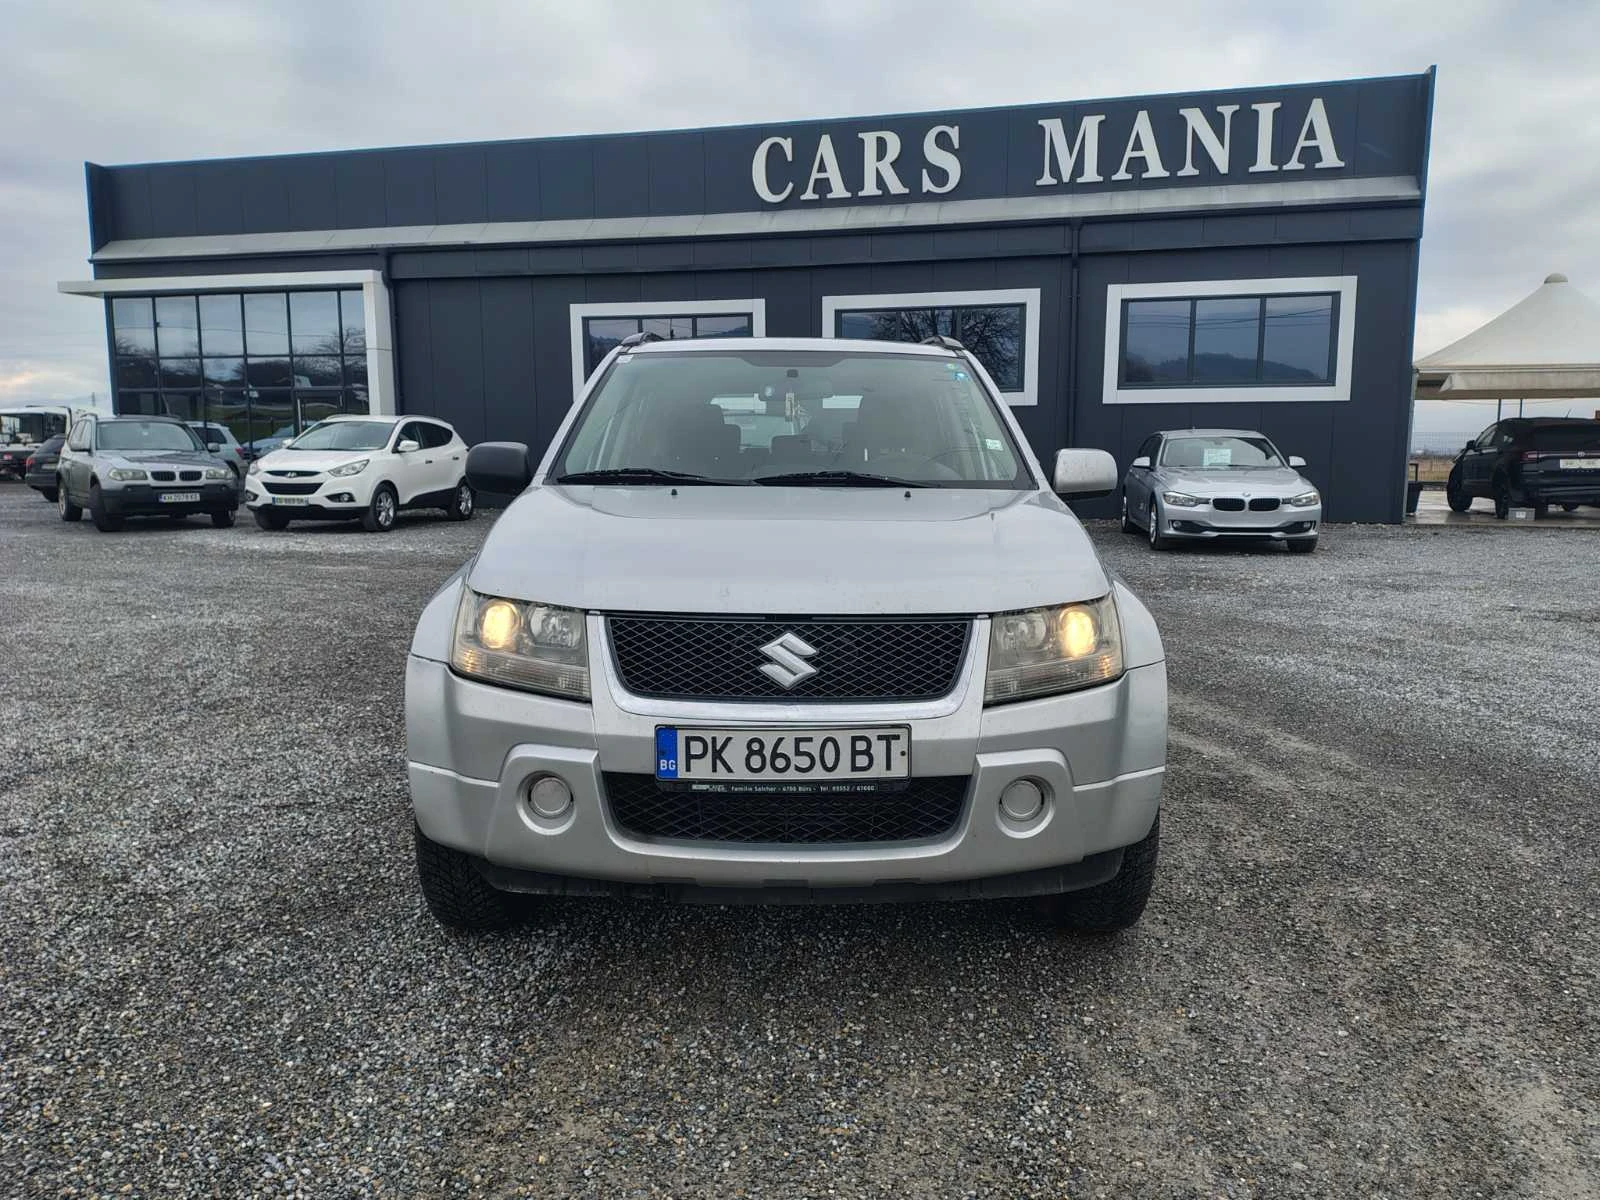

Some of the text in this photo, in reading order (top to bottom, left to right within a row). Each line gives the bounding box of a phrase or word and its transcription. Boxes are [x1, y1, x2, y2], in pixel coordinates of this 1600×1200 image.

[751, 97, 1346, 204] CARS MANIA
[660, 759, 676, 770] BG
[684, 734, 901, 773] PK 8650 BT
